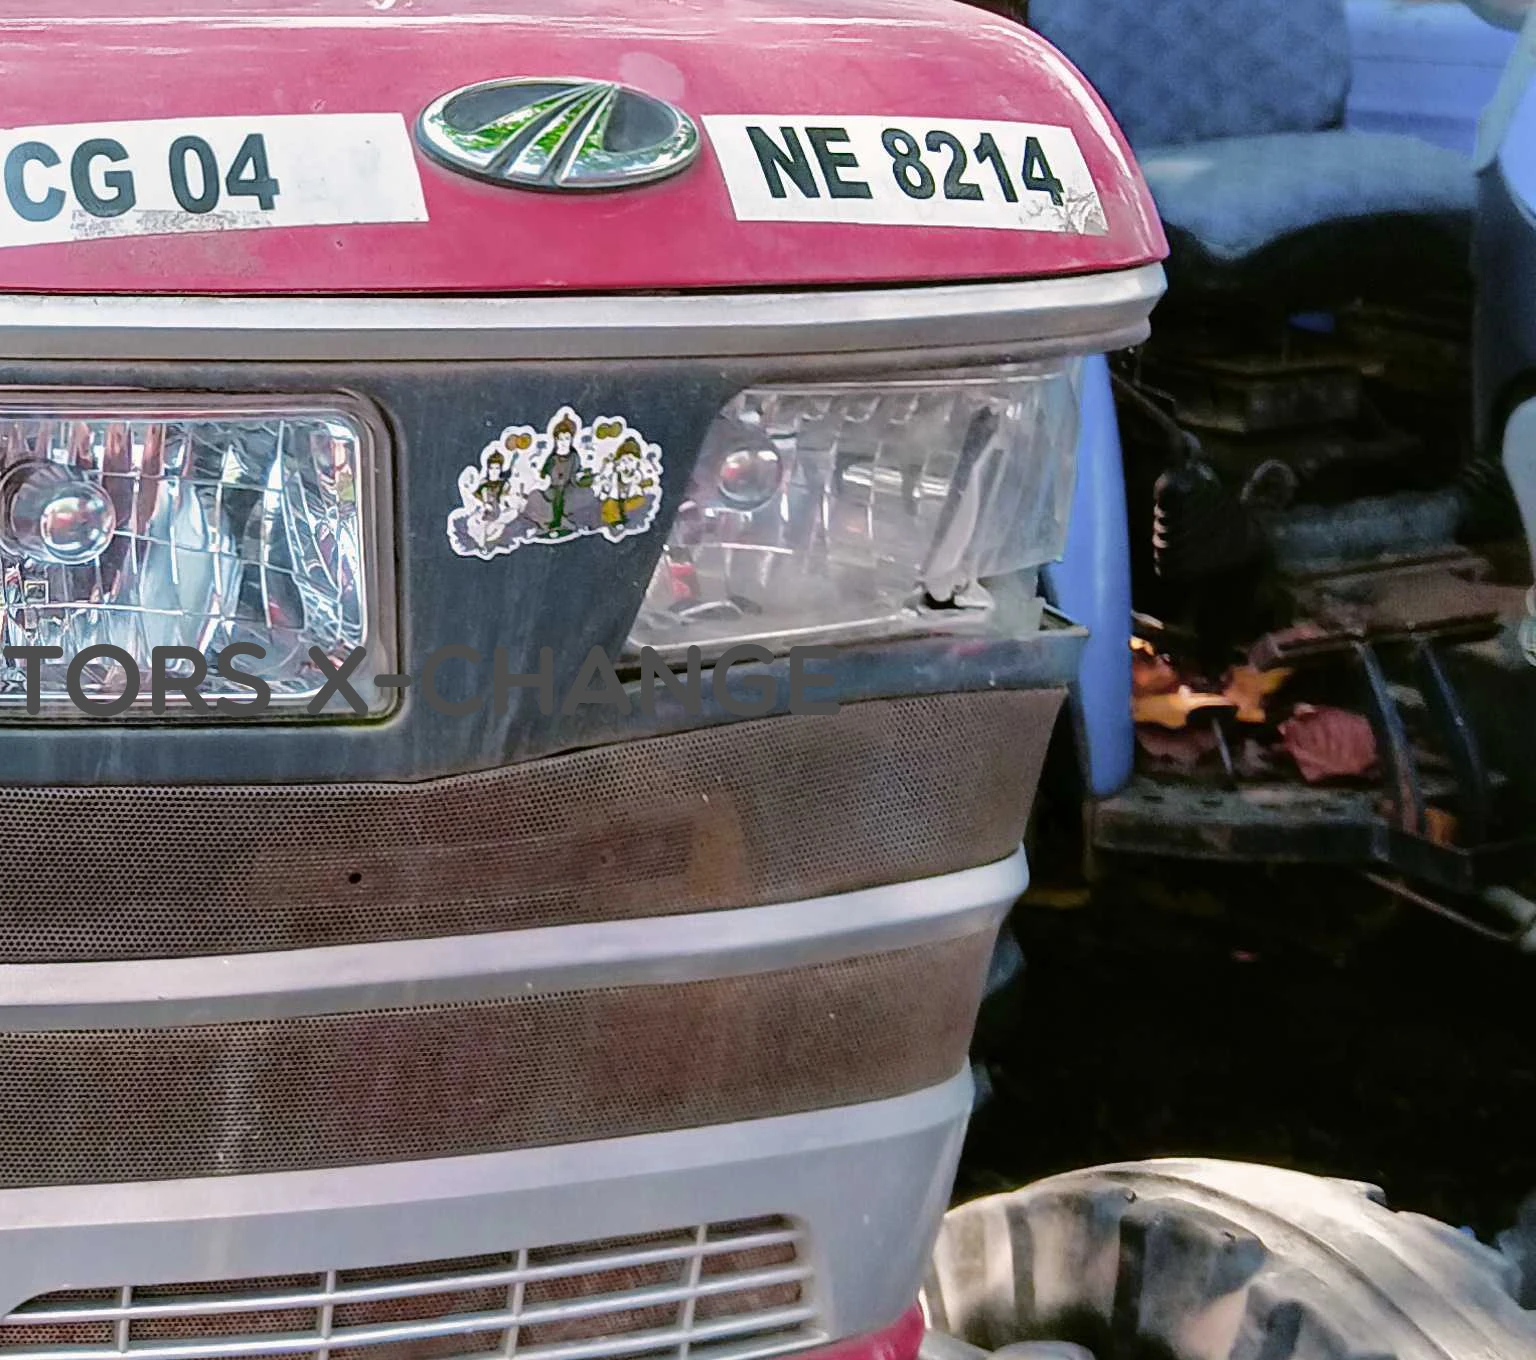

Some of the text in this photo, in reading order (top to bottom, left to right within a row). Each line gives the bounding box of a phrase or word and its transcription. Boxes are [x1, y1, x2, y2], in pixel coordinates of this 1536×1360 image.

[3, 132, 281, 223] CG 04
[744, 126, 1064, 206] NE 8214
